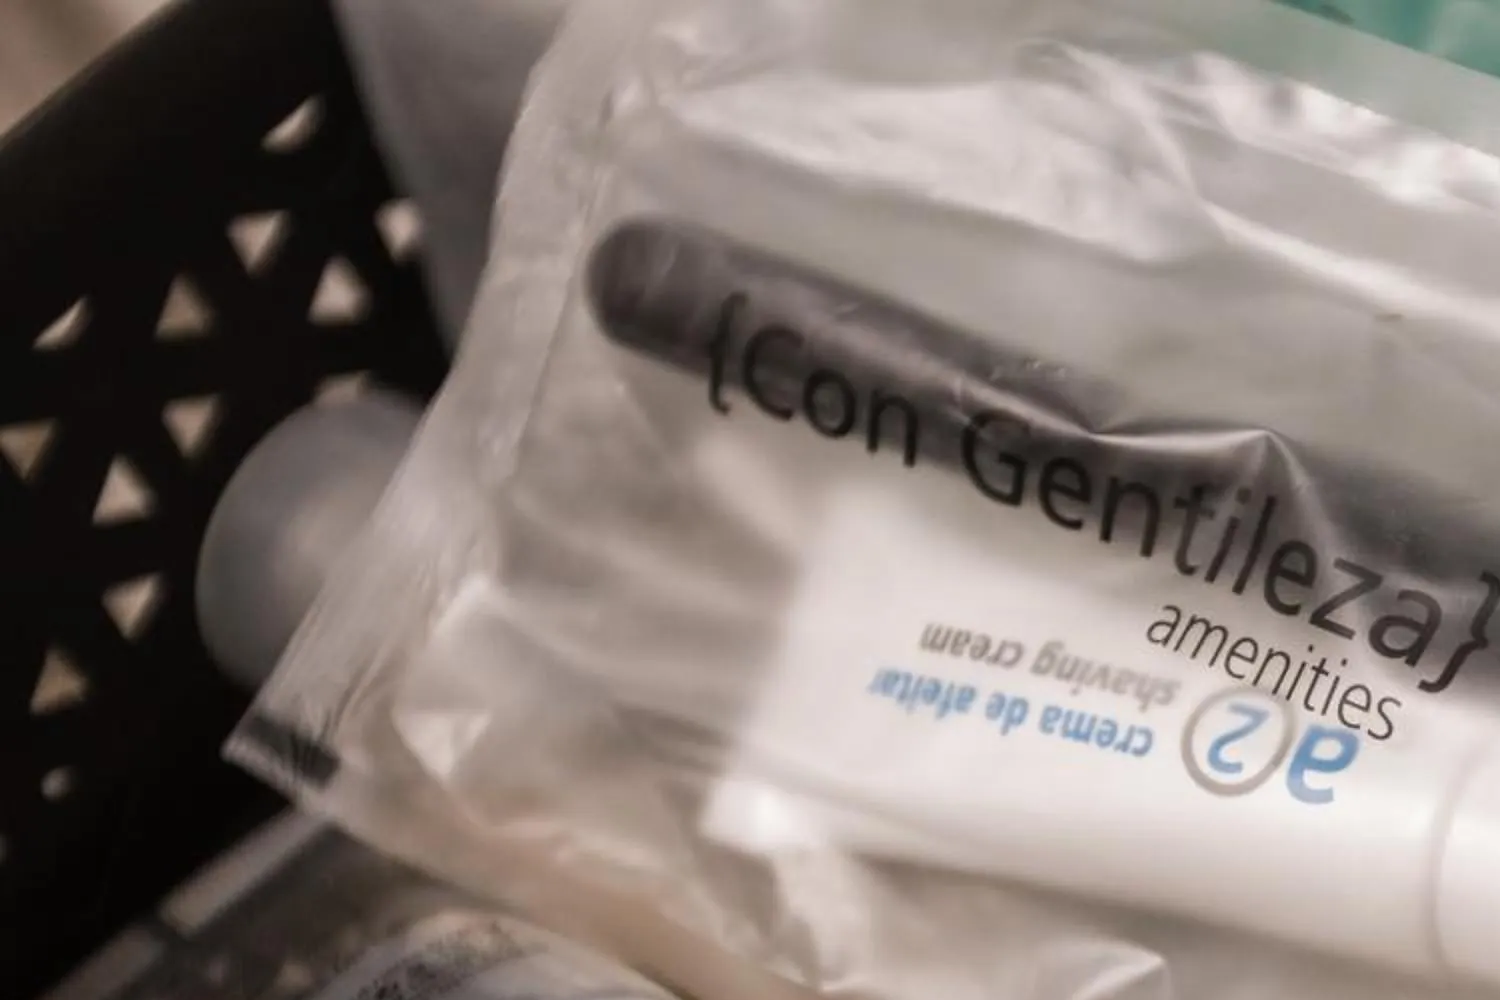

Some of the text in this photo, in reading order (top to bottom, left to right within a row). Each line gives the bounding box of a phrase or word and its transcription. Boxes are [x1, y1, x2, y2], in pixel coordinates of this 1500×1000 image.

[917, 622, 1181, 713] shaving cream
[1146, 603, 1404, 741] amenities
[984, 692, 1030, 737] de
[1038, 705, 1155, 759] crema
